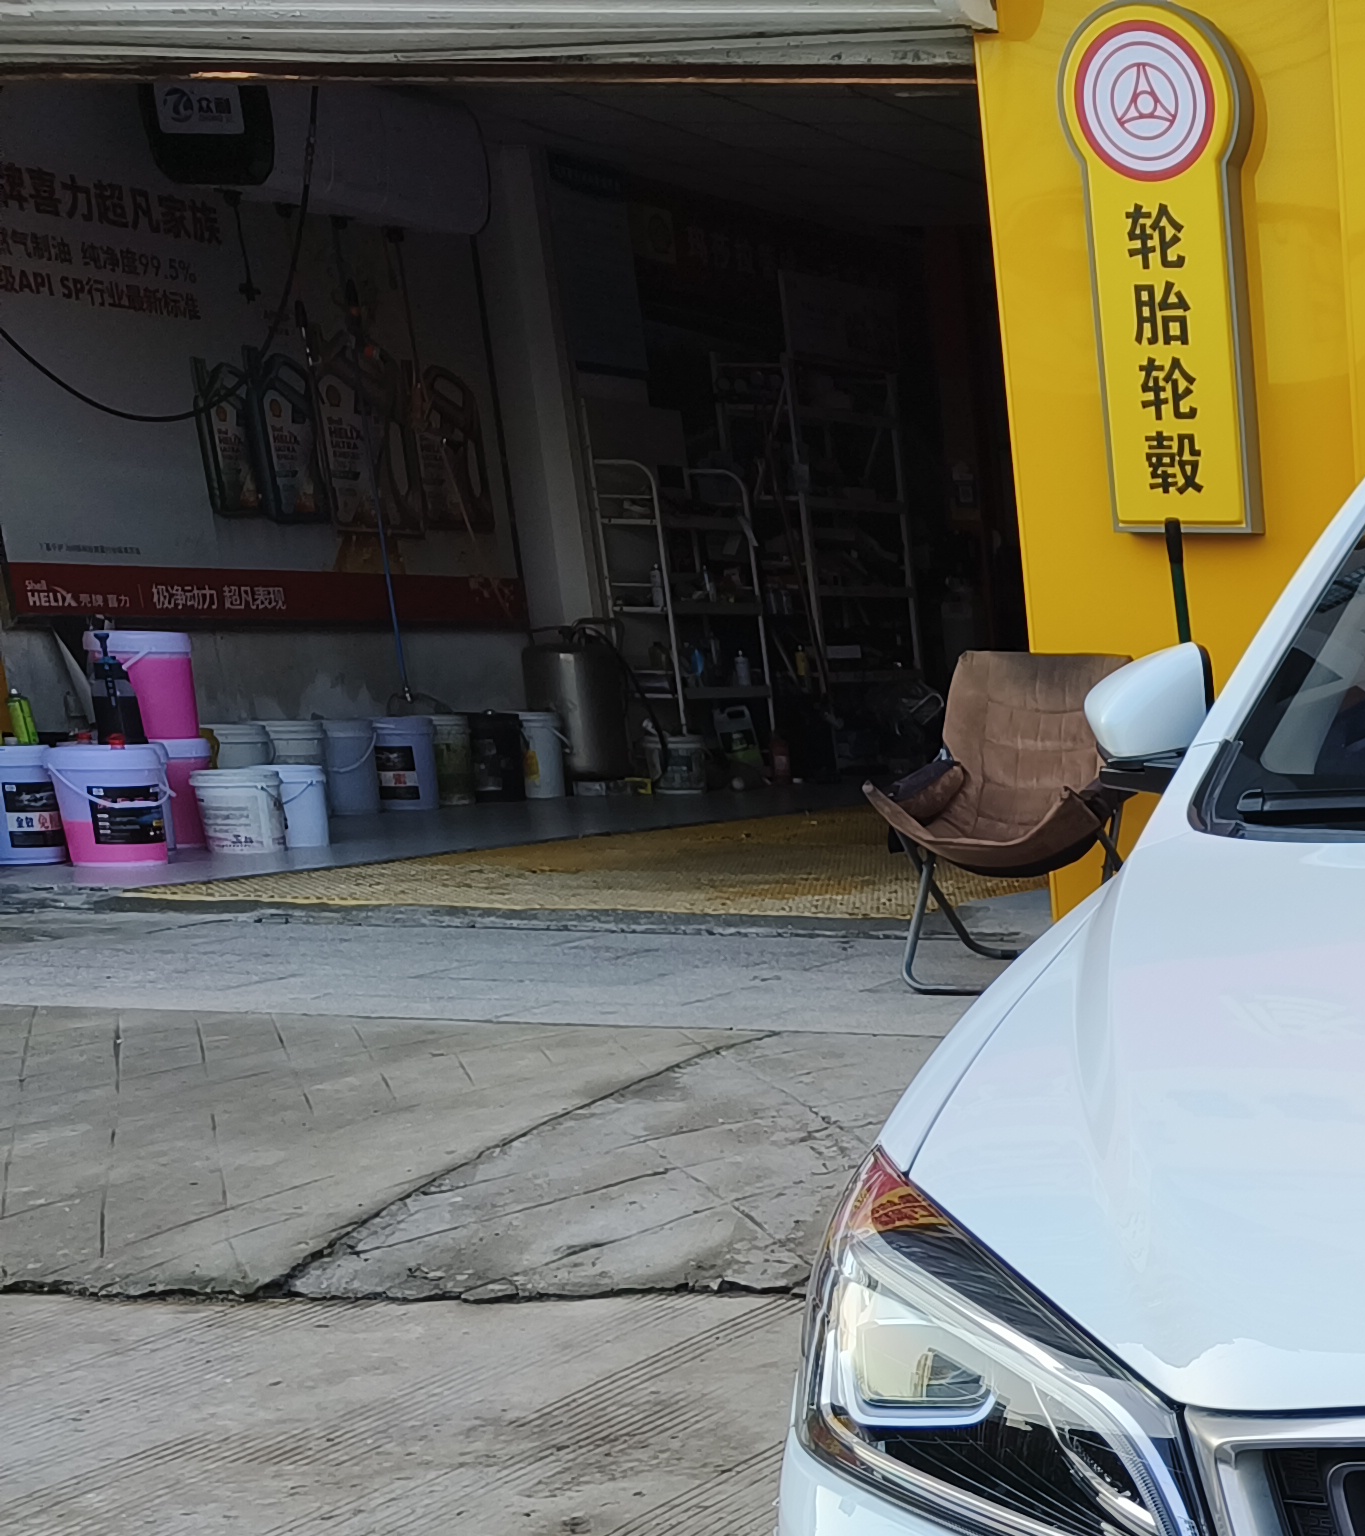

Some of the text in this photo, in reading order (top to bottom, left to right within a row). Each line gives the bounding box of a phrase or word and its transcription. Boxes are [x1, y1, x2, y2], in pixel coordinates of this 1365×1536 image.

[1125, 203, 1204, 495] 轮胎轮毂
[27, 588, 78, 607] HELIX
[152, 583, 217, 610] 极净动力
[222, 584, 286, 610] 超凡表现
